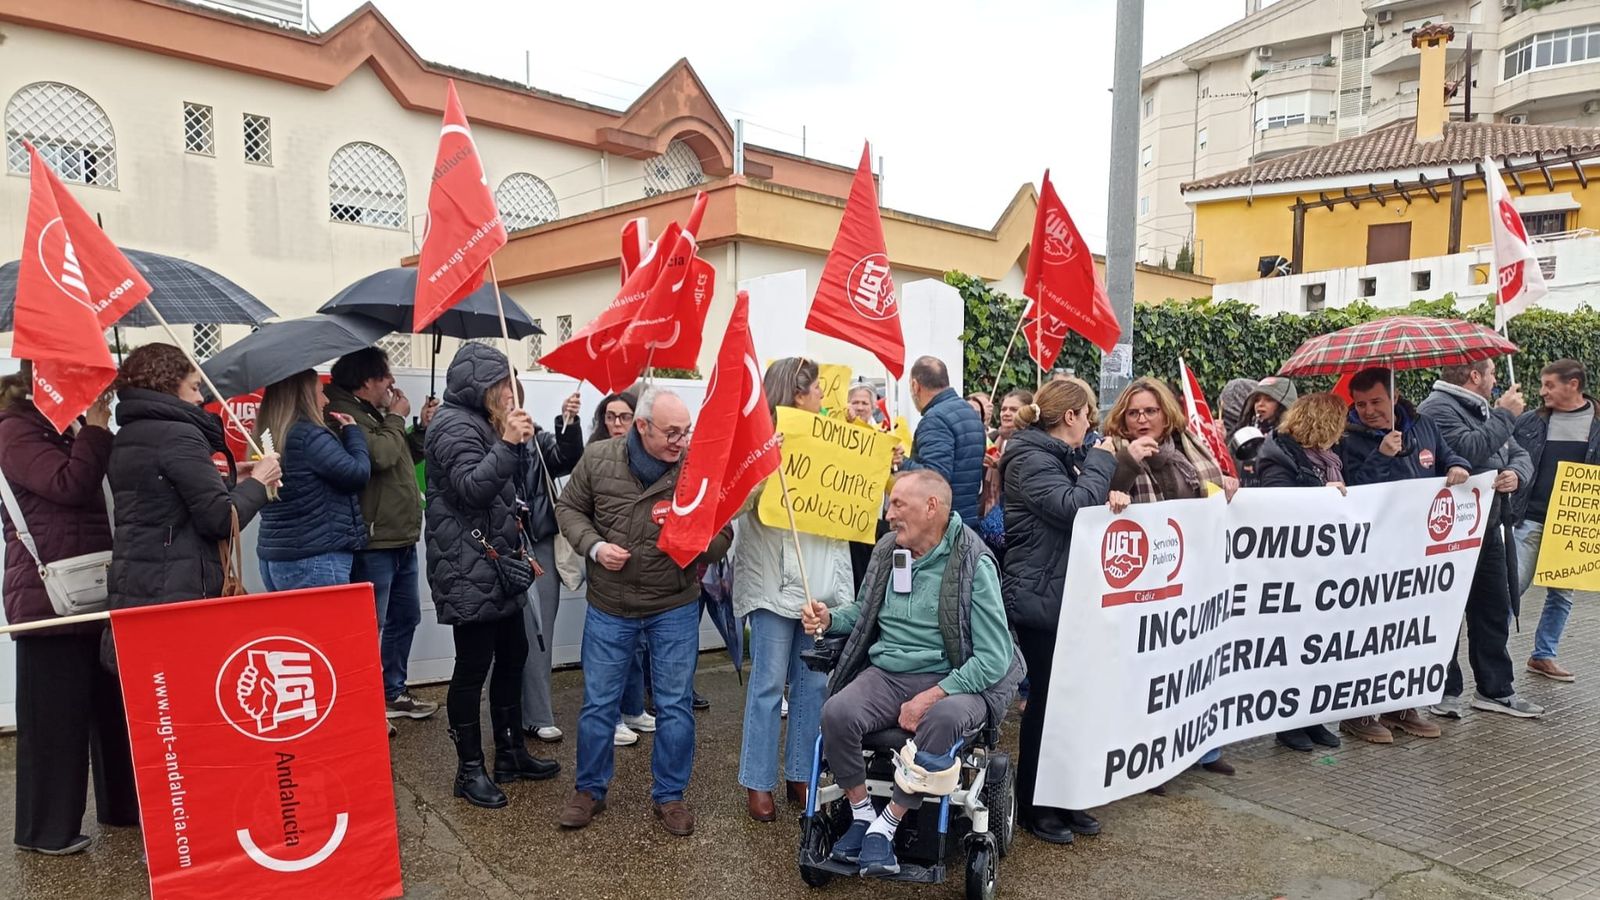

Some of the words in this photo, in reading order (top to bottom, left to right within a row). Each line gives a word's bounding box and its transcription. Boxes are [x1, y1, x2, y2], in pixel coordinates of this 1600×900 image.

[854, 260, 890, 310] UGT
[785, 453, 811, 480] NO
[820, 464, 878, 503] CUMPLE
[1430, 496, 1453, 520] UGT
[1105, 531, 1143, 560] UGT
[1225, 521, 1371, 564] DOMUSVI
[1564, 540, 1574, 551] A
[1579, 541, 1600, 554] SUS
[1137, 584, 1247, 653] INCUMPLE
[1258, 582, 1302, 614] EL
[1315, 562, 1455, 611] CONVENIO
[268, 651, 318, 723] UGT
[1147, 674, 1183, 715] EN
[1185, 636, 1288, 698] MATERIA
[1300, 615, 1437, 665] SALARIAL
[1104, 736, 1167, 788] POR
[1171, 687, 1300, 763] NUESTROS
[1309, 663, 1447, 714] DERECHO
[152, 671, 192, 868] www.ugt-andalucia.com
[275, 751, 305, 847] Andalucía
